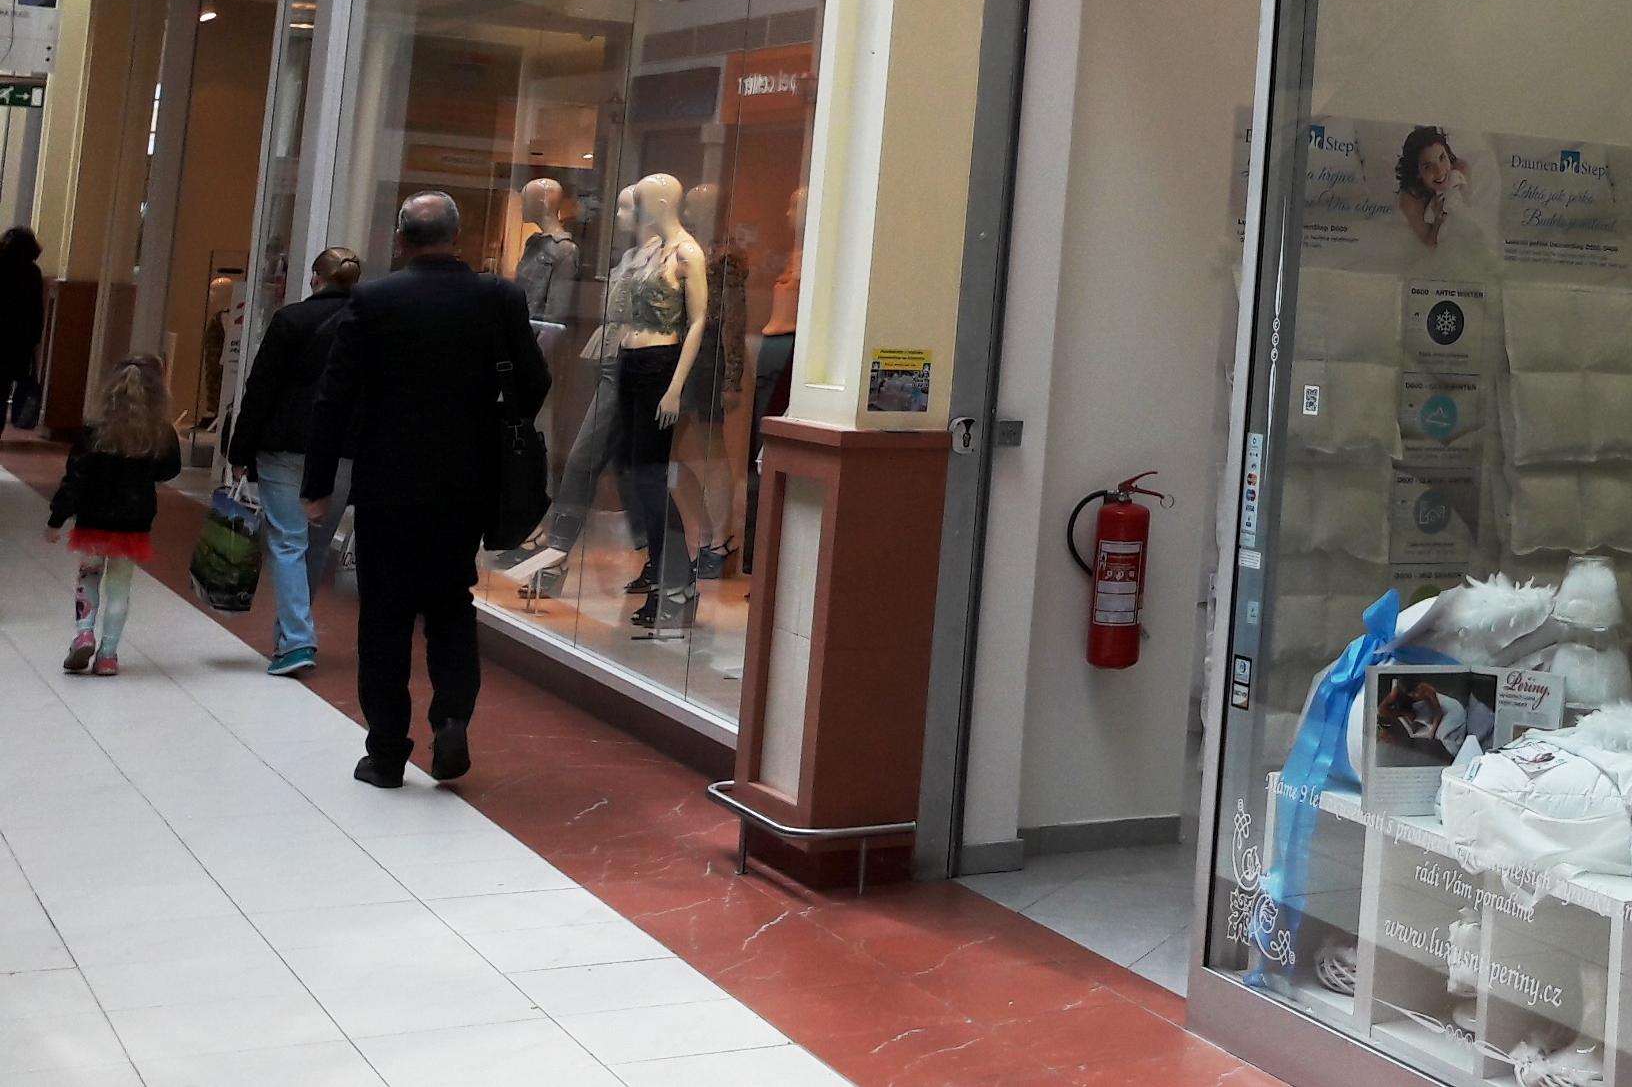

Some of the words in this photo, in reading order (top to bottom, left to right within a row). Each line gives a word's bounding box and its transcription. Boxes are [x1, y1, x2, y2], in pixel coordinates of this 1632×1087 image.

[1325, 136, 1354, 157] Step
[1511, 154, 1559, 172] Daunen
[1580, 161, 1606, 179] Step
[1300, 785, 1308, 803] 9
[1415, 861, 1439, 888] rádi
[1443, 869, 1473, 901] Vám
[1473, 887, 1536, 924] poradíme
